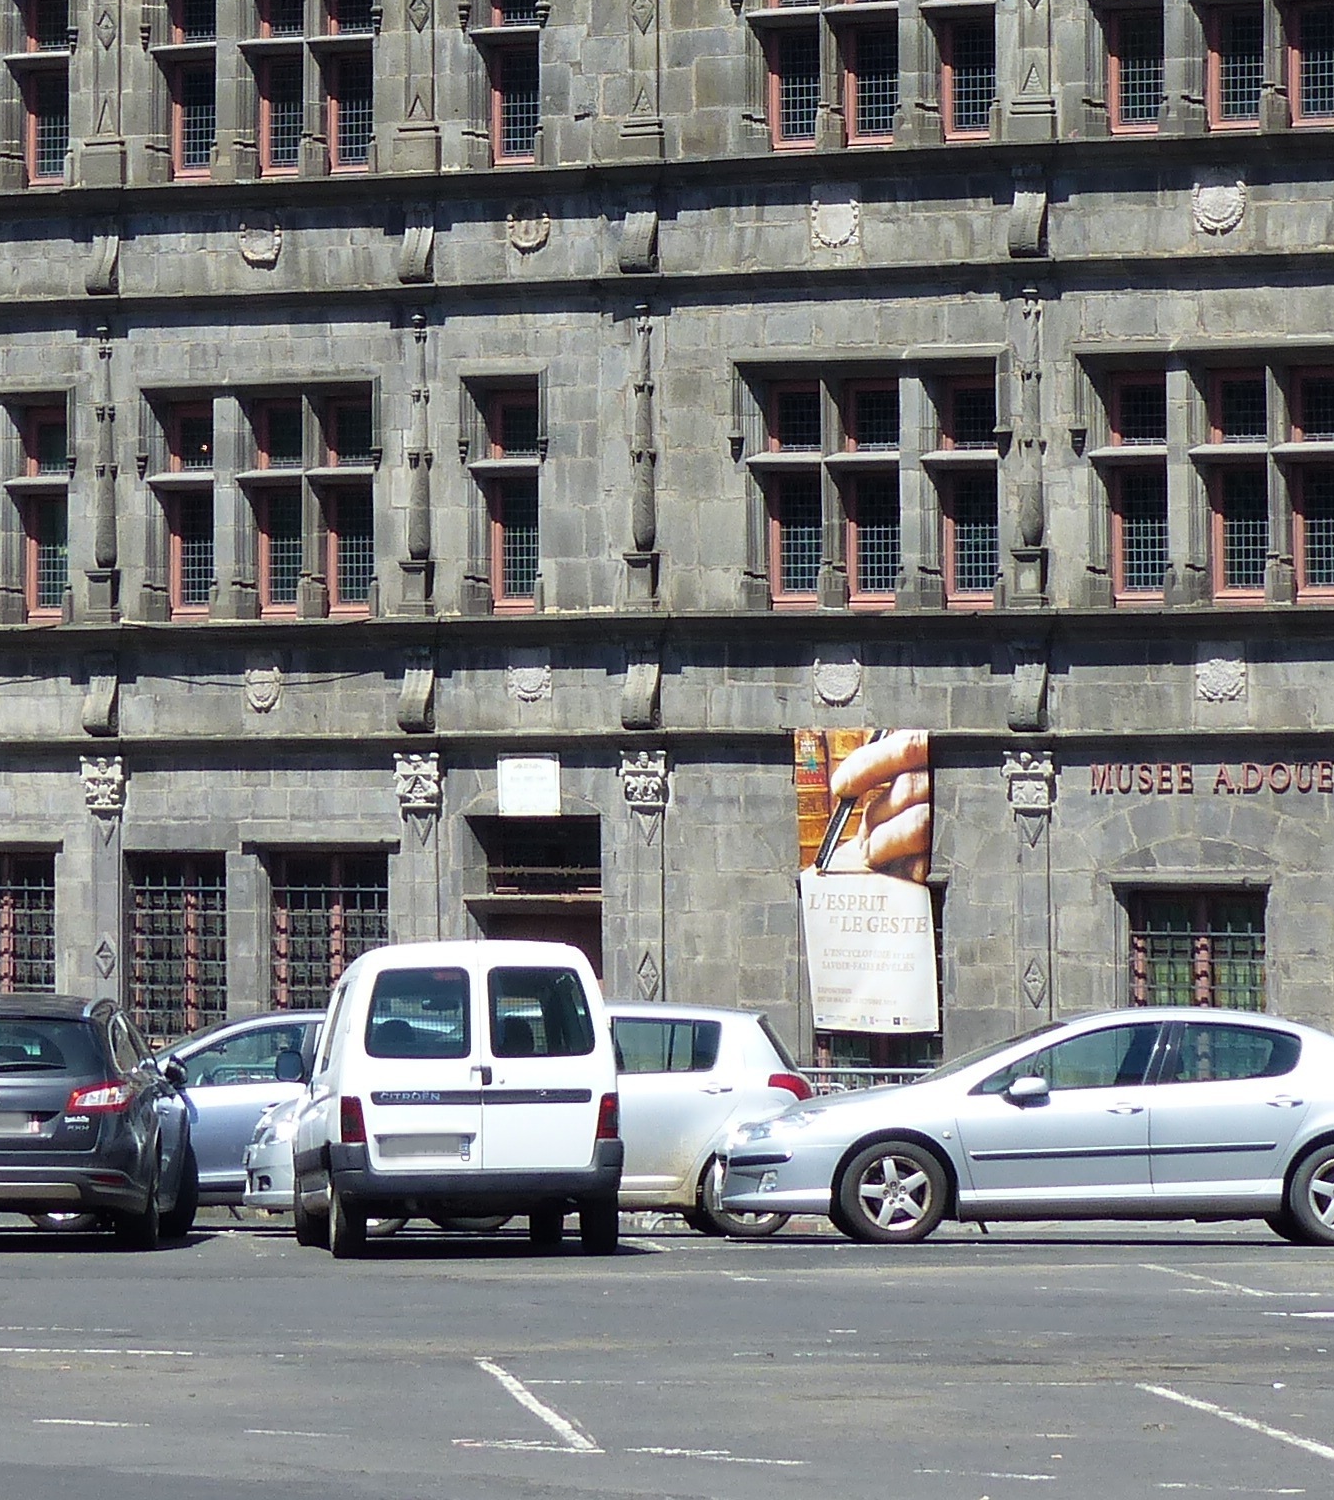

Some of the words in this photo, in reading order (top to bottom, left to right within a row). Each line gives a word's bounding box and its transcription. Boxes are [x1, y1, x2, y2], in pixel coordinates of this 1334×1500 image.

[1090, 763, 1194, 795] MUSEE
[809, 893, 889, 912] L'ESPRIT
[841, 916, 863, 933] LE
[867, 916, 928, 934] GESTE
